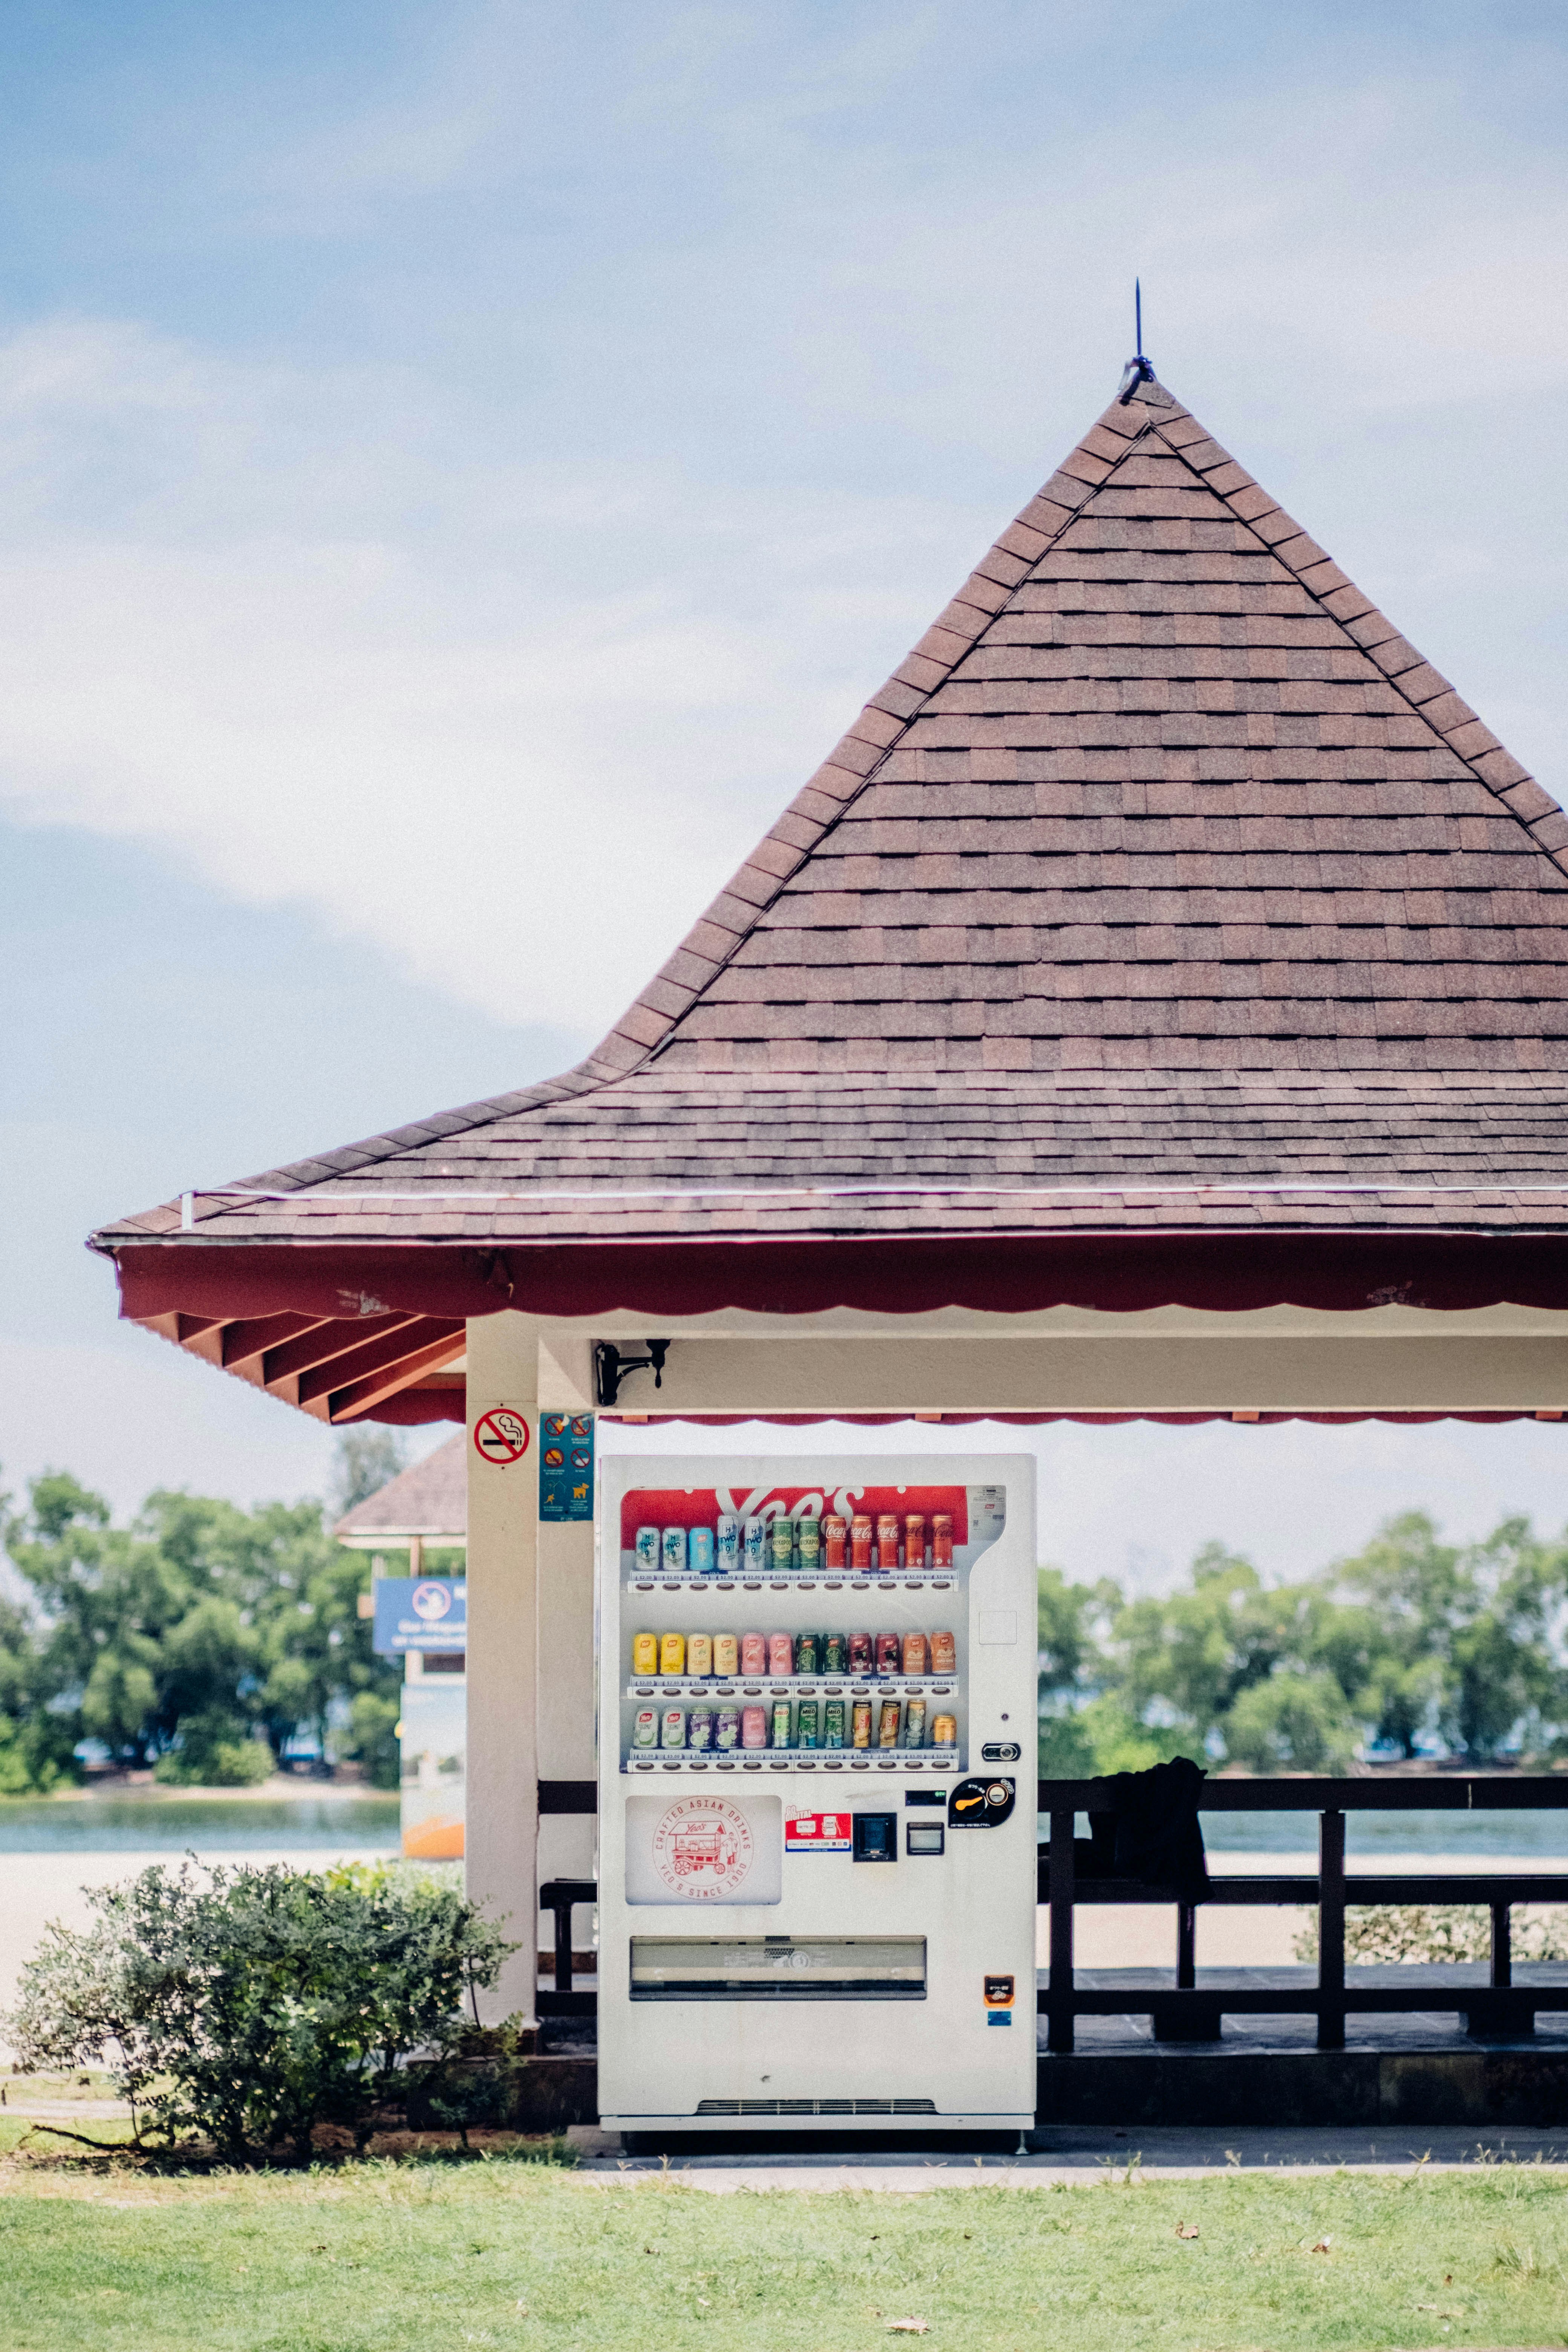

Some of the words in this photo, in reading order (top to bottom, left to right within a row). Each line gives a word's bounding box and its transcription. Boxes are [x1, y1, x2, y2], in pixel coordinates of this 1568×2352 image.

[720, 1535, 736, 1544] TWO
[746, 1537, 762, 1545] TWO
[656, 1807, 683, 1850] CRAFTED
[690, 1800, 724, 1811] ASIAN
[728, 1810, 750, 1849] DRINKS
[685, 1824, 706, 1834] Yeo's
[689, 1886, 722, 1897] SINCE
[727, 1863, 746, 1888] 1900
